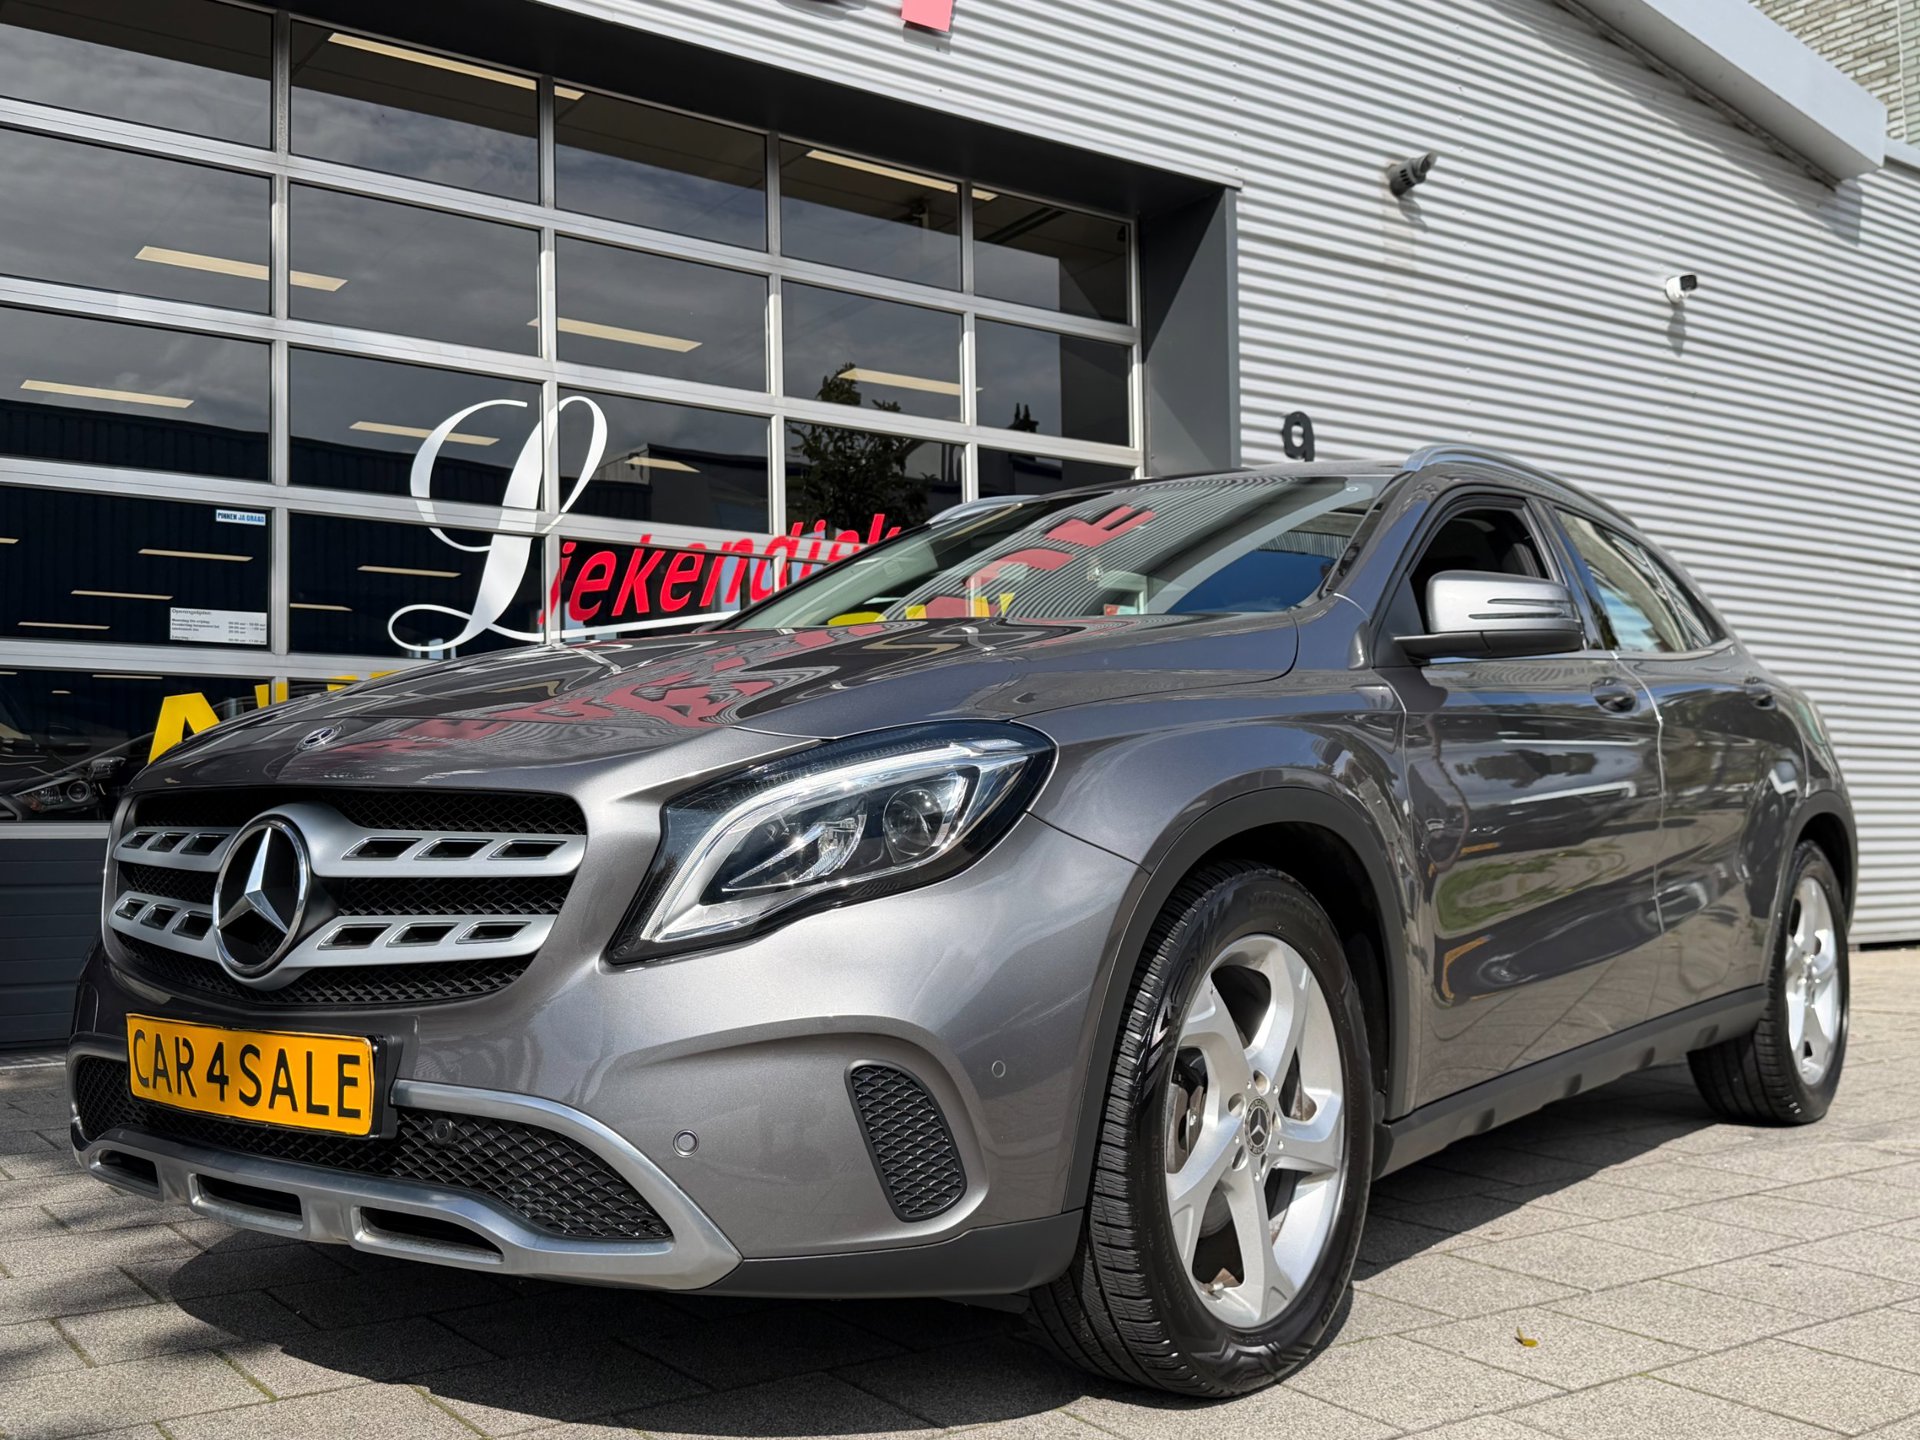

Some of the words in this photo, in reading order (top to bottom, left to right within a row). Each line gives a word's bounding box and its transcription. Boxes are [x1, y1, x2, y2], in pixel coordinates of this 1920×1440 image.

[132, 1028, 197, 1098] CAR
[206, 1041, 230, 1102] 4
[238, 1043, 362, 1119] SALE
